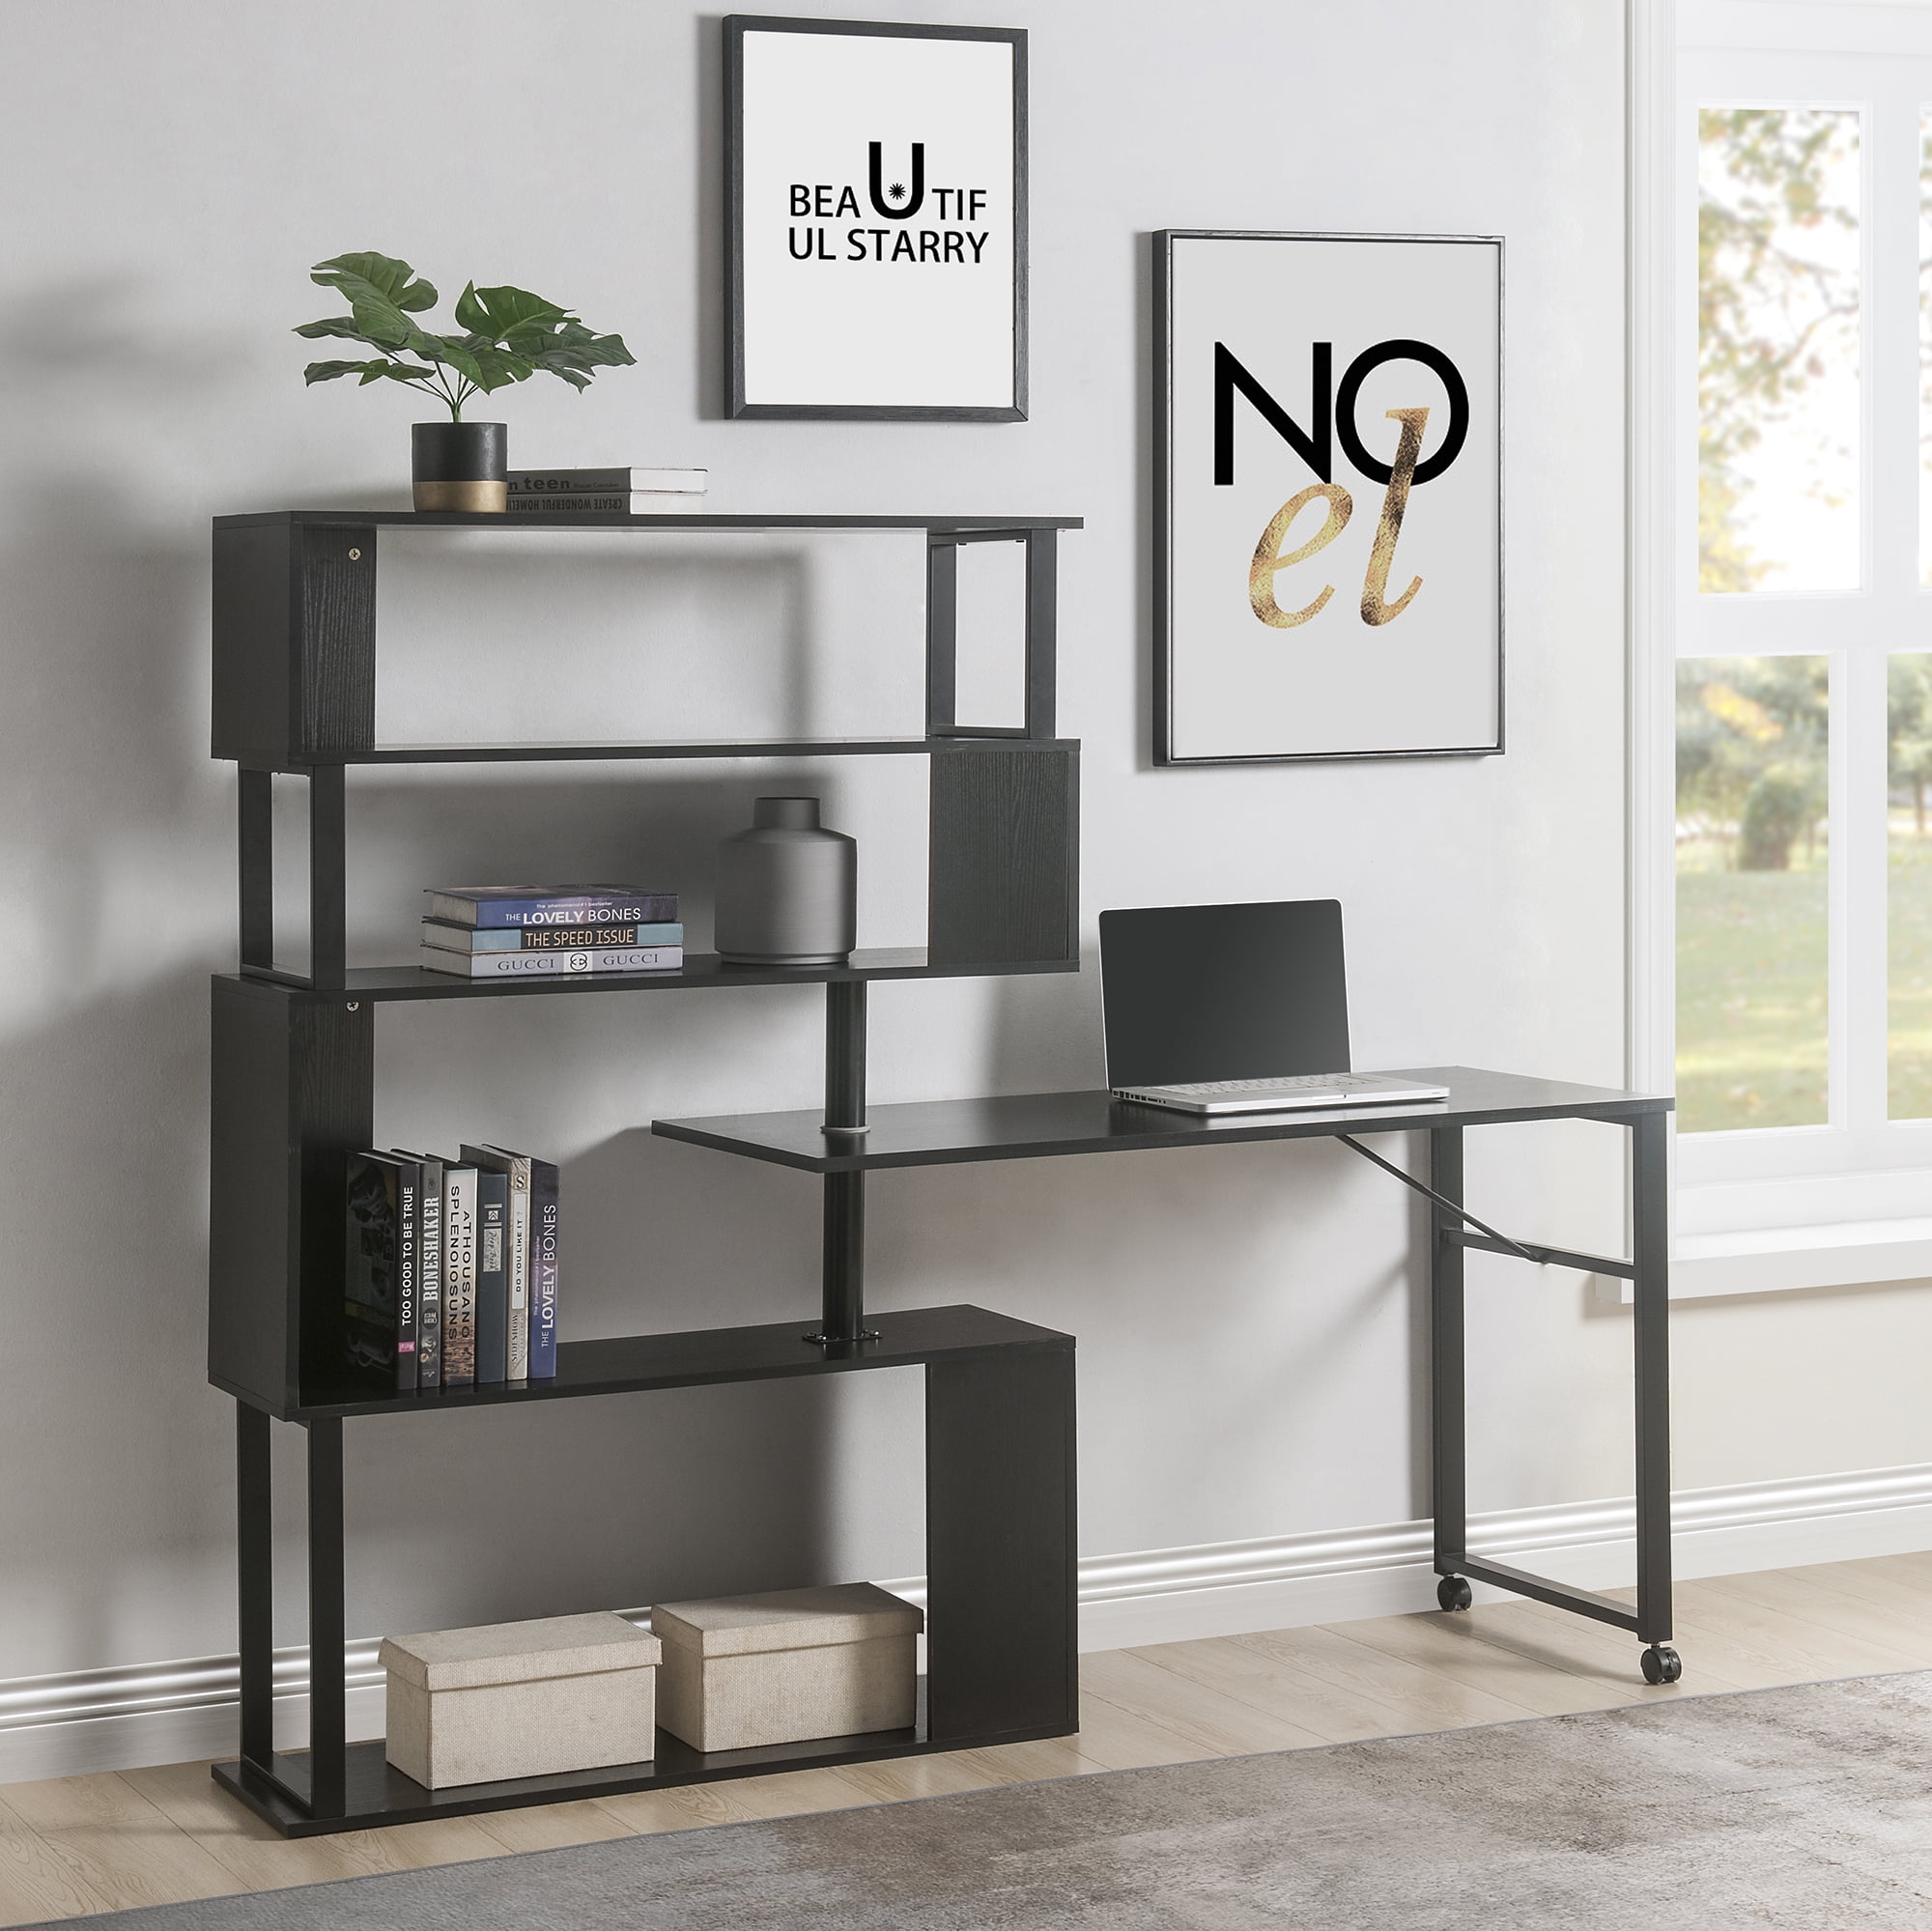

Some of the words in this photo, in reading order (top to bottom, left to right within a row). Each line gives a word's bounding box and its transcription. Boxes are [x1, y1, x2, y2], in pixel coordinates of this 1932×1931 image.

[789, 227, 837, 260] UL
[847, 228, 989, 264] STARRY
[1214, 339, 1469, 486] NO
[524, 476, 570, 489] teen
[541, 499, 592, 510] WONDERFUL
[594, 498, 623, 509] CREATE
[505, 913, 521, 922] THE
[523, 911, 584, 925] LOVELY
[587, 907, 641, 923] BONES
[526, 932, 550, 947] THE
[554, 930, 593, 946] SPEED
[596, 928, 635, 944] ISSUE
[497, 958, 555, 972] GUCCI
[603, 953, 659, 966] GUCCI
[403, 1186, 413, 1218] TRUE
[402, 1222, 413, 1238] BE
[516, 1218, 524, 1230] IT
[542, 1205, 557, 1262] BONES
[402, 1242, 413, 1259] TO
[423, 1196, 440, 1302] BONESHAKER
[402, 1262, 413, 1297] GOOD
[516, 1278, 523, 1292] DO
[541, 1264, 557, 1329] LOVELY
[402, 1299, 412, 1326] TOO
[510, 1315, 520, 1363] SIDESHOW
[540, 1331, 550, 1348] THE
